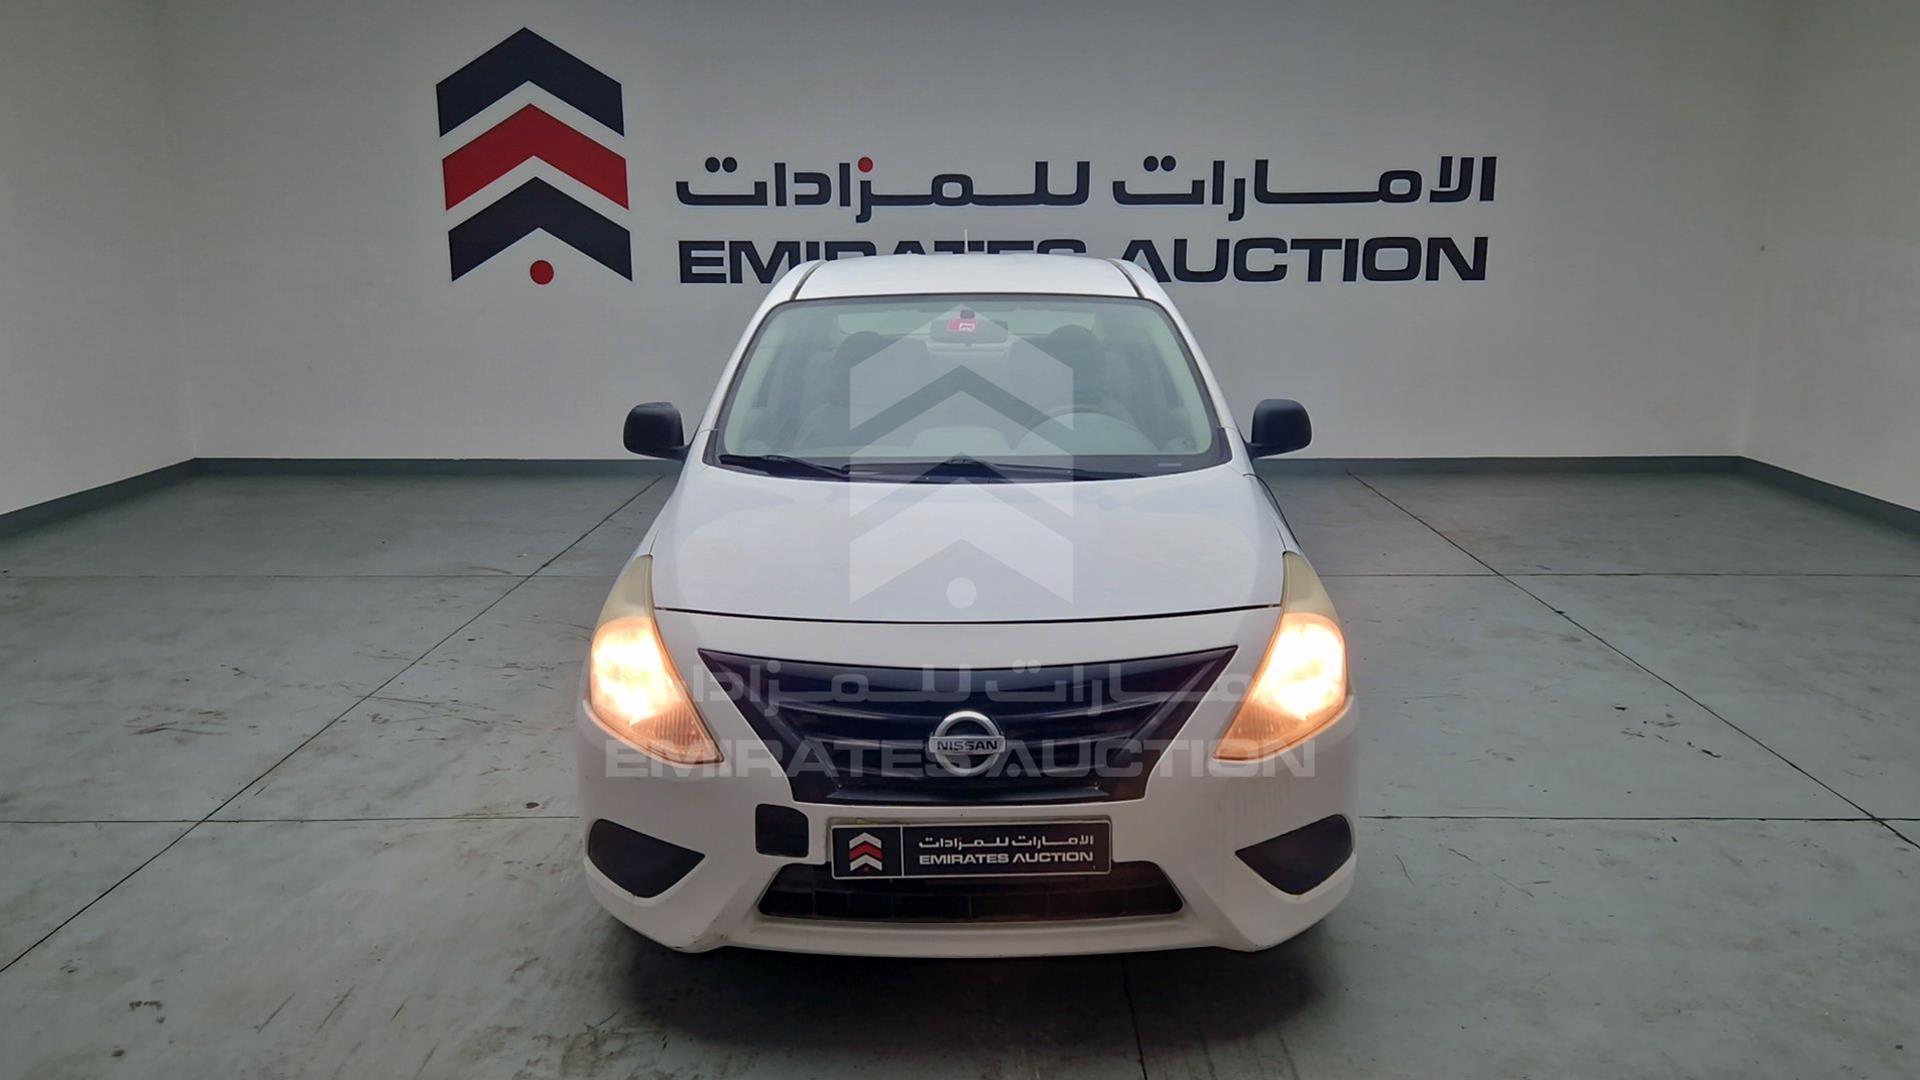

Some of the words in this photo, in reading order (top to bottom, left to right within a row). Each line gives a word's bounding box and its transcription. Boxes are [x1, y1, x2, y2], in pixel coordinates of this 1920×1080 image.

[675, 156, 1090, 223] للمزادات
[1112, 155, 1497, 221] الامارات
[1121, 237, 1488, 282] AUCTION
[936, 740, 998, 751] NISSAN
[919, 852, 1009, 865] EMIRATES
[1012, 851, 1094, 863] AUCTION
